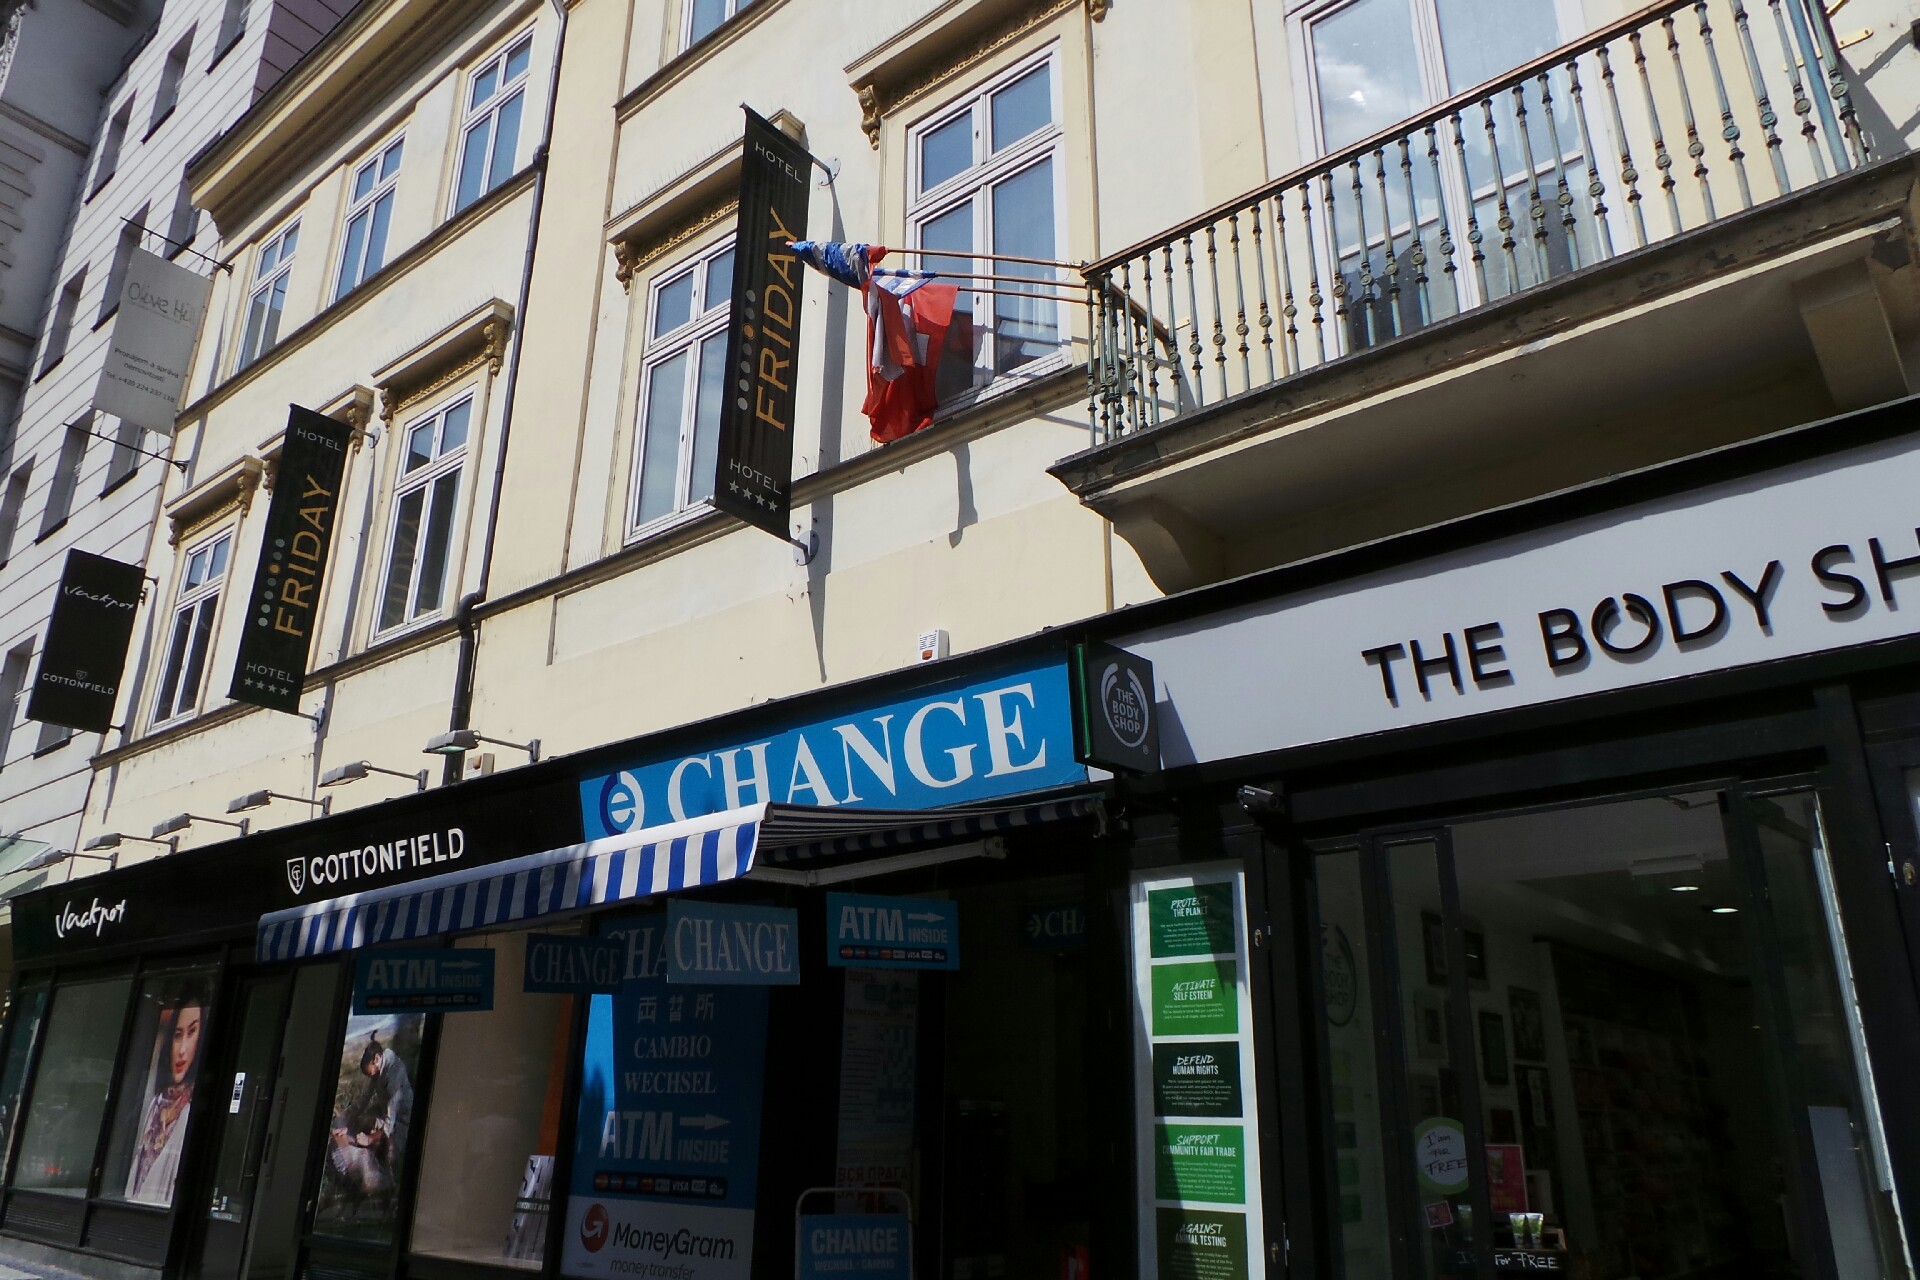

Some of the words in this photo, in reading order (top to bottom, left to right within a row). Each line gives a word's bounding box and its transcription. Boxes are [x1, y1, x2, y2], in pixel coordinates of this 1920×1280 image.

[755, 141, 802, 183] HOTEL
[756, 207, 798, 432] FRIDAY
[297, 427, 342, 452] HOTEL
[730, 457, 783, 497] HOTEL
[275, 474, 332, 637] FRIDAY
[1353, 622, 1511, 700] THE
[1537, 558, 1784, 669] BODY
[246, 661, 295, 684] HOTEL
[42, 672, 115, 696] COTTONFIELD
[1115, 687, 1135, 706] THE
[1112, 701, 1139, 721] BODY
[1114, 715, 1141, 734] SHOP
[667, 681, 1047, 824] CHANGE
[310, 827, 465, 885] COTTONFIELD
[1170, 896, 1209, 910] PROTECT
[1173, 908, 1185, 918] THE
[1186, 906, 1208, 917] PLANET
[55, 898, 128, 939] Jackpot
[838, 905, 904, 942] ATM
[674, 916, 792, 974] CHANGE
[908, 927, 948, 944] INSIDE
[530, 941, 620, 985] CHANGE
[366, 960, 436, 990] ATM
[441, 974, 483, 988] INSIDE
[1172, 979, 1216, 993] ACTIVATE
[1174, 991, 1189, 1001] SELF
[1189, 990, 1213, 1001] ESTEEM
[633, 1035, 712, 1059] CAMBIO
[1172, 1065, 1195, 1076] HUMAN
[1195, 1065, 1219, 1075] RIGHTS
[1176, 1054, 1215, 1066] DEFEND
[624, 1071, 717, 1094] WECHSEL
[598, 1111, 674, 1161] ATM
[1176, 1134, 1220, 1146] SUPPORT
[677, 1139, 729, 1164] INSIDE
[1162, 1144, 1199, 1156] COMMUNITY
[1199, 1146, 1214, 1156] FAIR
[1215, 1147, 1236, 1158] TRADE
[838, 1167, 864, 1182] ВСЯ
[868, 1166, 909, 1182] ПРАГА
[1425, 1158, 1467, 1176] FREE
[672, 1180, 689, 1192] VISA
[1179, 1223, 1224, 1234] AGAINST
[613, 1222, 735, 1260] MoneyGram
[811, 1227, 898, 1256] CHANGE
[1175, 1233, 1199, 1246] ANIMAL
[1199, 1235, 1227, 1247] TESTING
[610, 1258, 649, 1278] money
[650, 1262, 695, 1280] transfer
[815, 1259, 855, 1272] WECHSEL
[861, 1258, 895, 1271] CAMBIO
[1494, 1254, 1512, 1266] For
[1511, 1252, 1561, 1269] FREE
